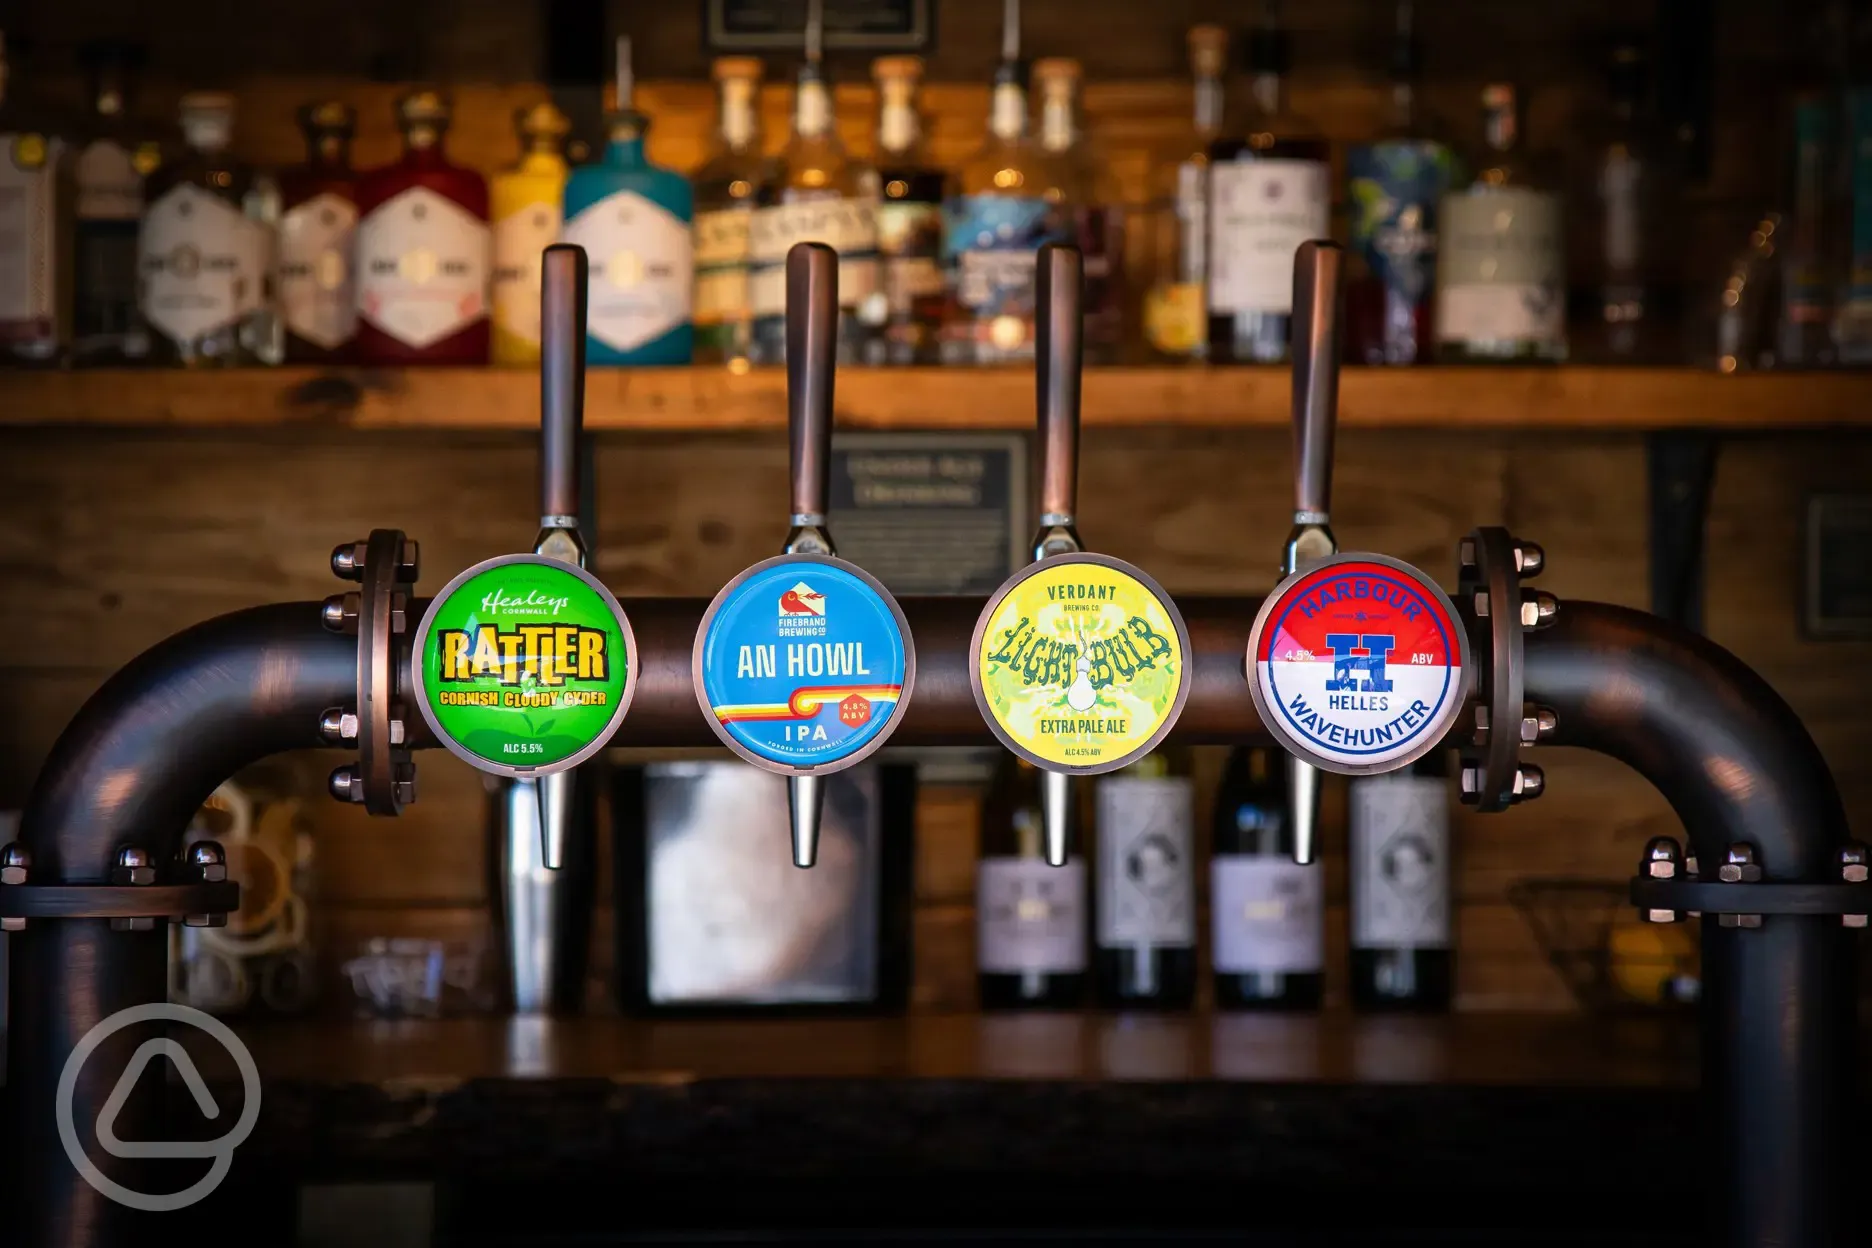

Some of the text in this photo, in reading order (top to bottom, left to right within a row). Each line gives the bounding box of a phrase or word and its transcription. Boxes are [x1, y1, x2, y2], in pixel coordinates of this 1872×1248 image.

[1047, 584, 1117, 600] VERDANT
[481, 588, 569, 615] Healeys
[1063, 604, 1090, 612] BREWING
[1300, 580, 1422, 622] HARBOUR
[778, 617, 826, 627] FIREBRAND
[778, 627, 818, 637] BREWING
[440, 623, 608, 686] RATTLER
[737, 642, 870, 679] AN HOWL
[1089, 615, 1173, 691] BULB
[1285, 649, 1434, 665] 4.5% ABV
[439, 691, 607, 708] CORNISH CLOUDY CYDER
[842, 702, 868, 711] 4.8%
[1329, 695, 1389, 711] HELLES
[842, 711, 865, 719] ABV
[1289, 693, 1431, 746] WAVEHUNTER
[785, 725, 828, 742] IPA
[1040, 719, 1126, 734] EXTRA PALE ALE
[503, 744, 543, 754] ALC 5.5%
[767, 740, 794, 752] FORGED
[1064, 748, 1102, 756] ALC 4.5% ABV
